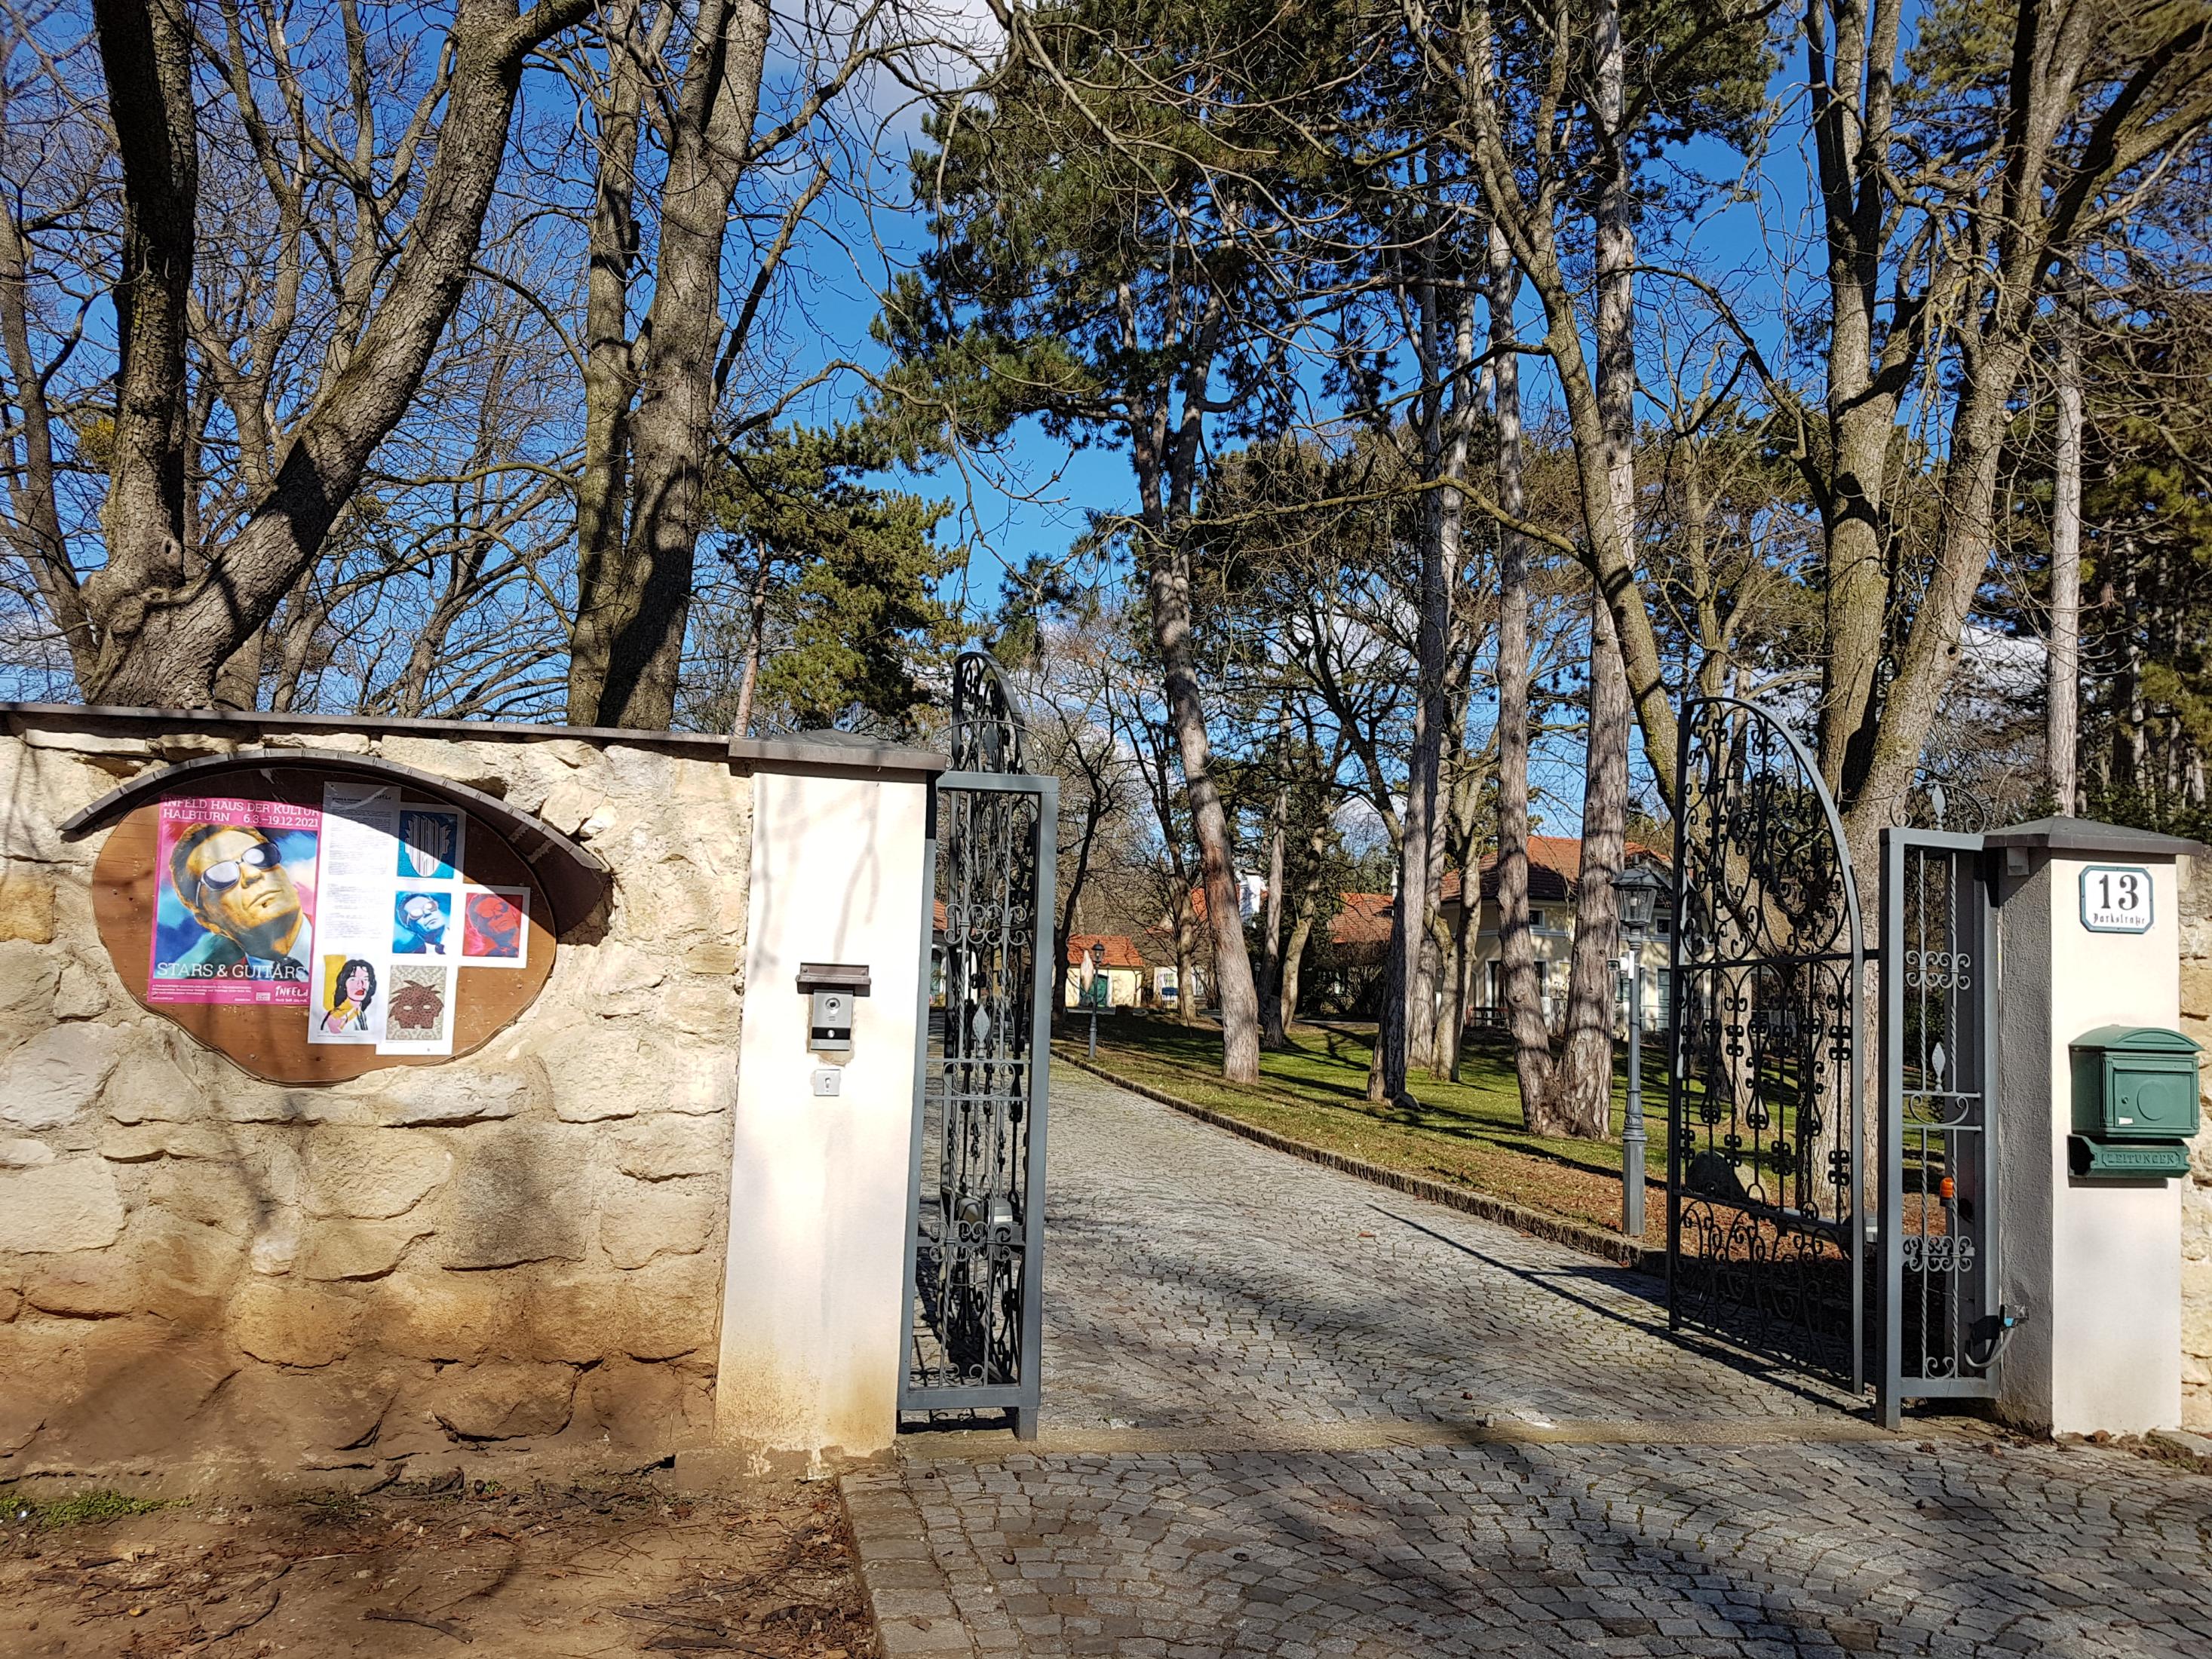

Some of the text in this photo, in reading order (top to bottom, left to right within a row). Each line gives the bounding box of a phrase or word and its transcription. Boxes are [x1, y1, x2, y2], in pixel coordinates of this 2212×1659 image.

[163, 797, 320, 817] INFELD HAUS DER KULTUR
[163, 808, 230, 822] HALBTURN
[2099, 874, 2139, 910] 13
[157, 962, 305, 979] STARS & GUITARS
[2107, 1152, 2174, 1165] ZEITUNGEN
